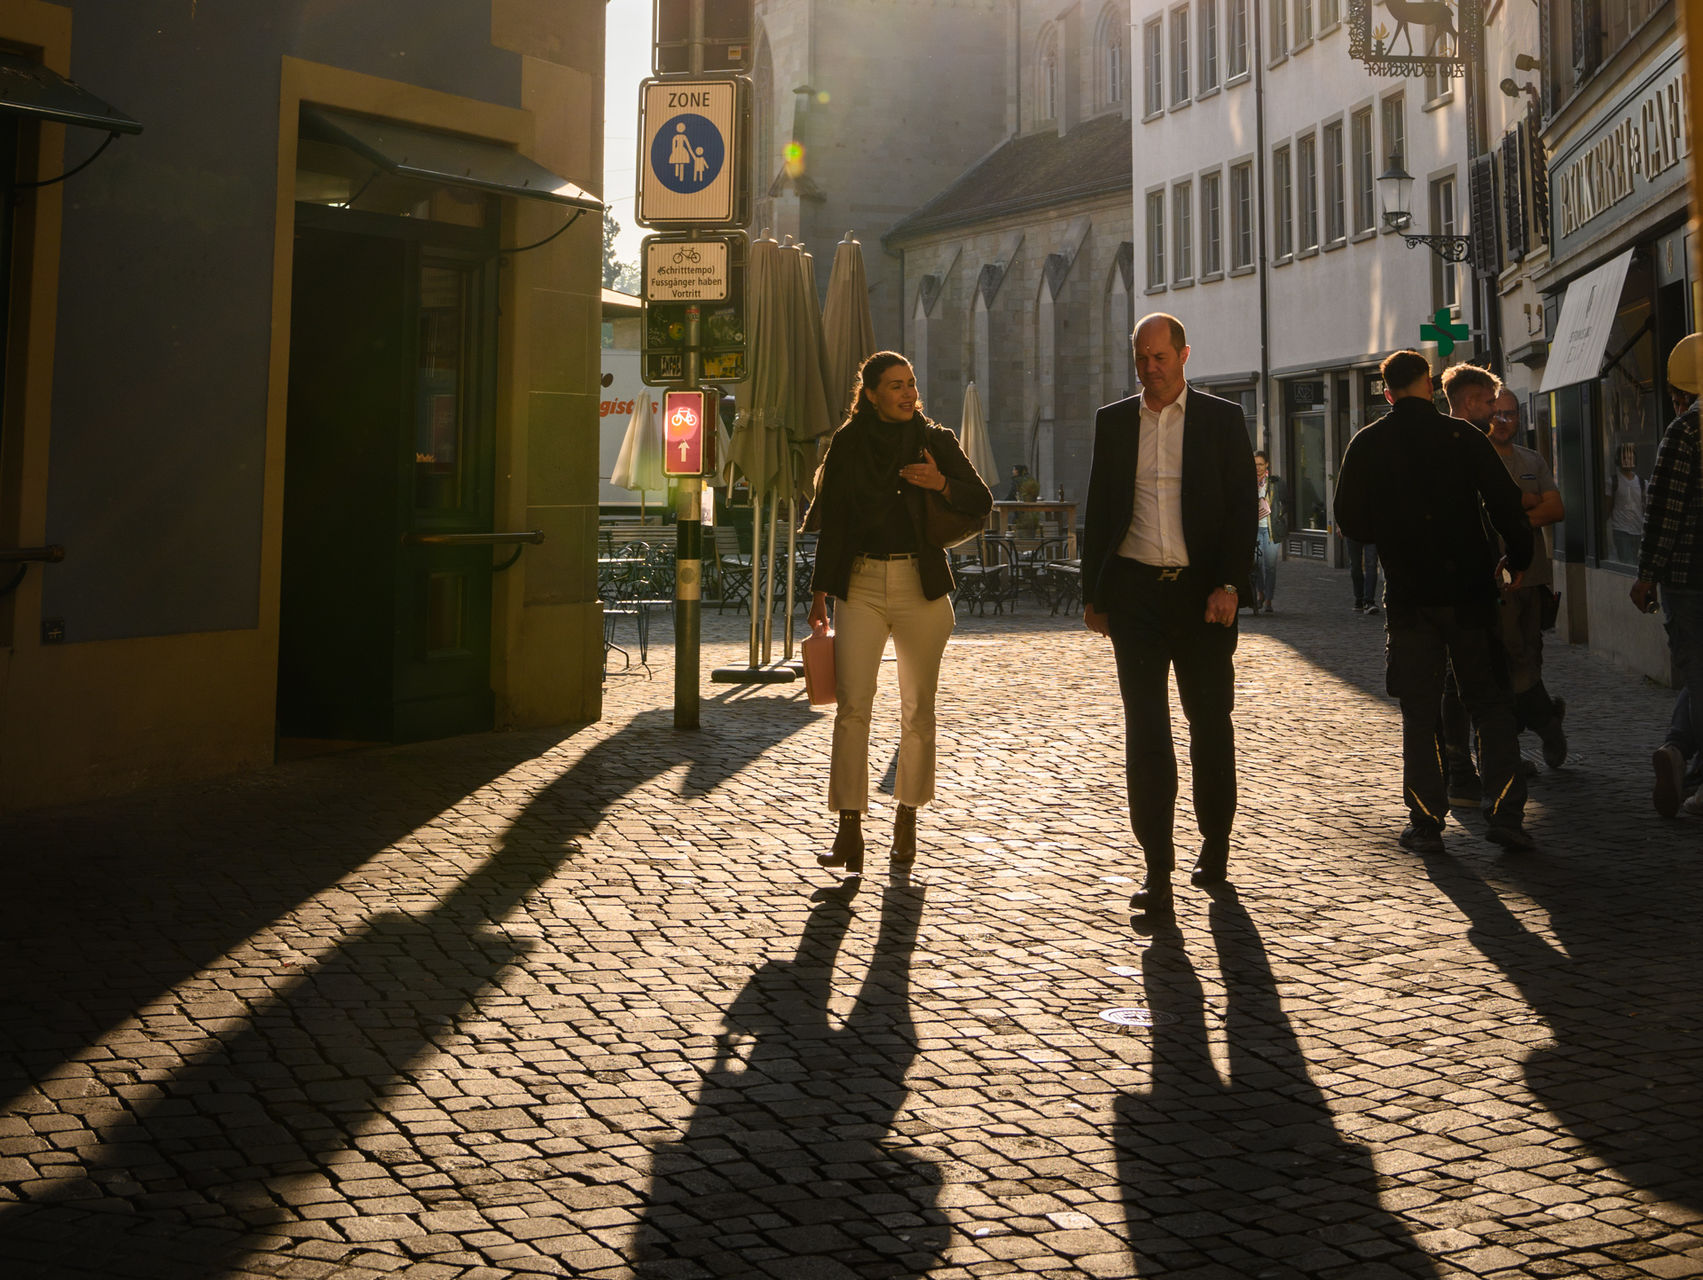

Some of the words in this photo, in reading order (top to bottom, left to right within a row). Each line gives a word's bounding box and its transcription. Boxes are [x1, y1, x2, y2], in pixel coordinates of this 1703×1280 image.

[668, 92, 711, 108] ZONE
[651, 277, 696, 288] Fussgänger
[698, 276, 722, 286] haben
[672, 288, 702, 298] Vortritt
